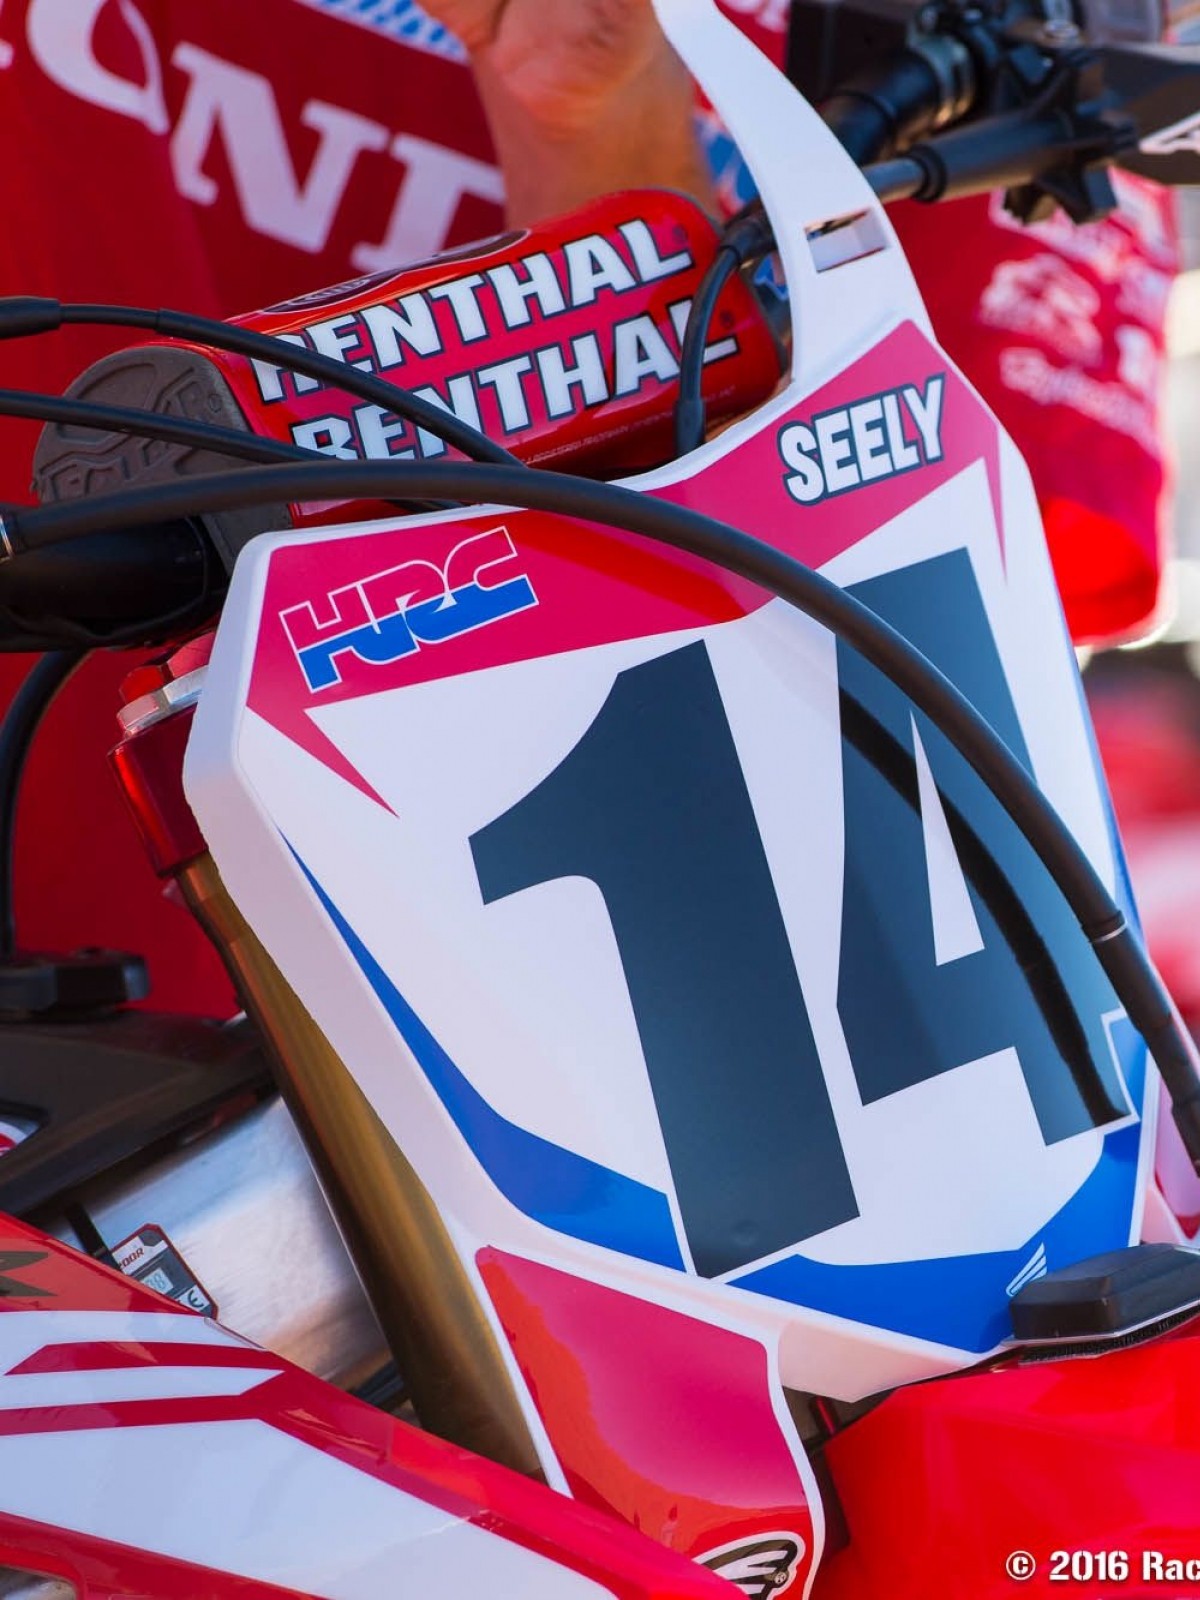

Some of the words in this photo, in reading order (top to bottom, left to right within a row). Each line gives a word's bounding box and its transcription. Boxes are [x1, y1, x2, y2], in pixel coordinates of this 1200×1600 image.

[777, 372, 946, 507] SEELY
[279, 525, 539, 693] HRC
[468, 546, 1131, 1279] 14
